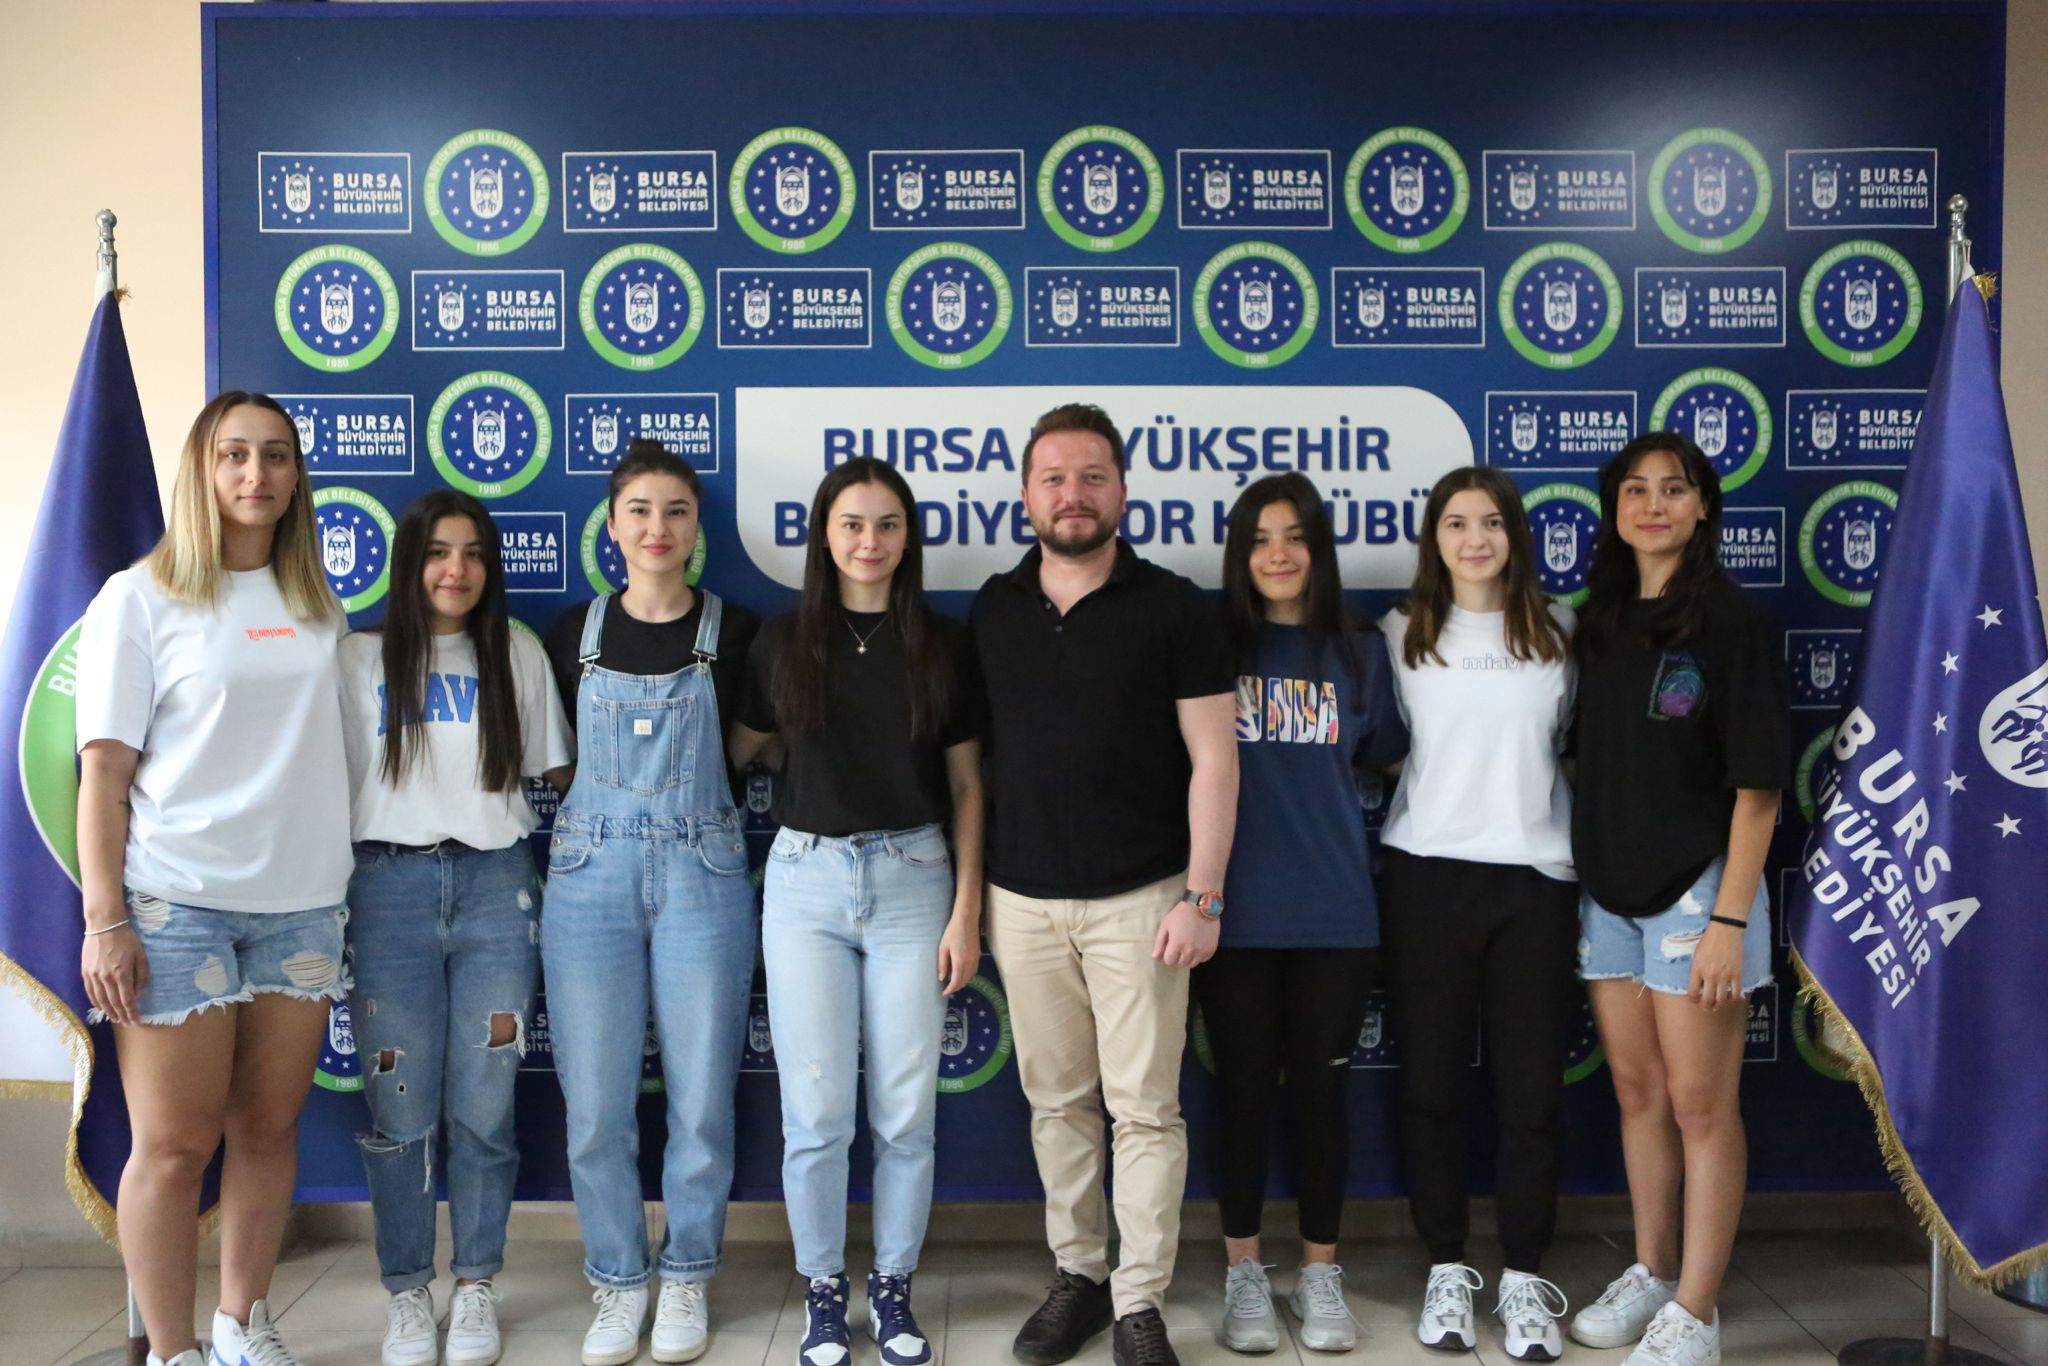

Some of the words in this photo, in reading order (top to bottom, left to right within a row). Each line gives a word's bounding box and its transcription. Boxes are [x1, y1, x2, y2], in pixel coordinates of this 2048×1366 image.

[332, 172, 402, 188] BURSA
[638, 171, 708, 187] BURSA
[944, 170, 1016, 186] BURSA
[1252, 170, 1323, 186] BURSA
[1558, 170, 1628, 186] BURSA
[1860, 168, 1928, 184] BURSA
[332, 188, 402, 202] BÜYÜKŞEHİR
[638, 187, 708, 200] BÜYÜKŞEHİR
[944, 186, 1016, 199] BÜYÜKŞEHİR
[1252, 186, 1323, 199] BÜYÜKŞEHİR
[1860, 184, 1928, 197] BÜYÜKŞEHİR
[332, 200, 403, 214] BELEDİYESİ
[638, 199, 708, 212] BELEDİYESİ
[944, 198, 1016, 211] BELEDİYESİ
[1252, 198, 1324, 211] BELEDİYESİ
[1860, 196, 1928, 209] BELEDİYESİ
[486, 290, 556, 306] BURSA
[792, 288, 862, 304] BURSA
[1100, 286, 1171, 302] BURSA
[1406, 288, 1477, 304] BURSA
[1708, 287, 1777, 303] BURSA
[486, 306, 556, 320] BÜYÜKŞEHİR
[792, 304, 862, 318] BÜYÜKŞEHİR
[1100, 302, 1171, 316] BÜYÜKŞEHİR
[486, 318, 556, 332] BELEDİYESİ
[792, 316, 863, 330] BELEDİYESİ
[1100, 314, 1172, 328] BELEDİYESİ
[1406, 316, 1478, 328] BELEDİYESİ
[1708, 315, 1778, 328] BELEDİYESİ
[336, 414, 405, 430] BURSA
[429, 423, 442, 458] BURSA
[480, 374, 545, 416] BELEDİYESPOR
[640, 413, 709, 430] BURSA
[1558, 412, 1628, 428] BURSA
[336, 430, 405, 444] BÜYÜKŞEHİR
[1859, 424, 1917, 438] BÜYÜKŞEH
[336, 442, 406, 456] BELEDİYESİ
[662, 440, 710, 454] EDİYESİ
[823, 427, 1015, 472] BURSA
[1031, 415, 1391, 486] YÜKŞEHİR
[1859, 437, 1914, 450] BELEDİY
[478, 484, 501, 494] 1980
[502, 532, 557, 548] URSA
[1722, 527, 1776, 543] URSA
[501, 547, 557, 561] YÜKŞEHİR
[1720, 542, 1776, 556] YÜKŞEHİR
[503, 559, 557, 573] LEDİYESİ
[1722, 555, 1777, 568] LEDİYESİ
[1267, 677, 1339, 744] NBA
[1833, 706, 1981, 947] BURSA
[1817, 767, 1931, 977] ÜYÜKŞEHİR
[1803, 846, 1916, 1009] EDİYESİ
[335, 1079, 358, 1088] 1980
